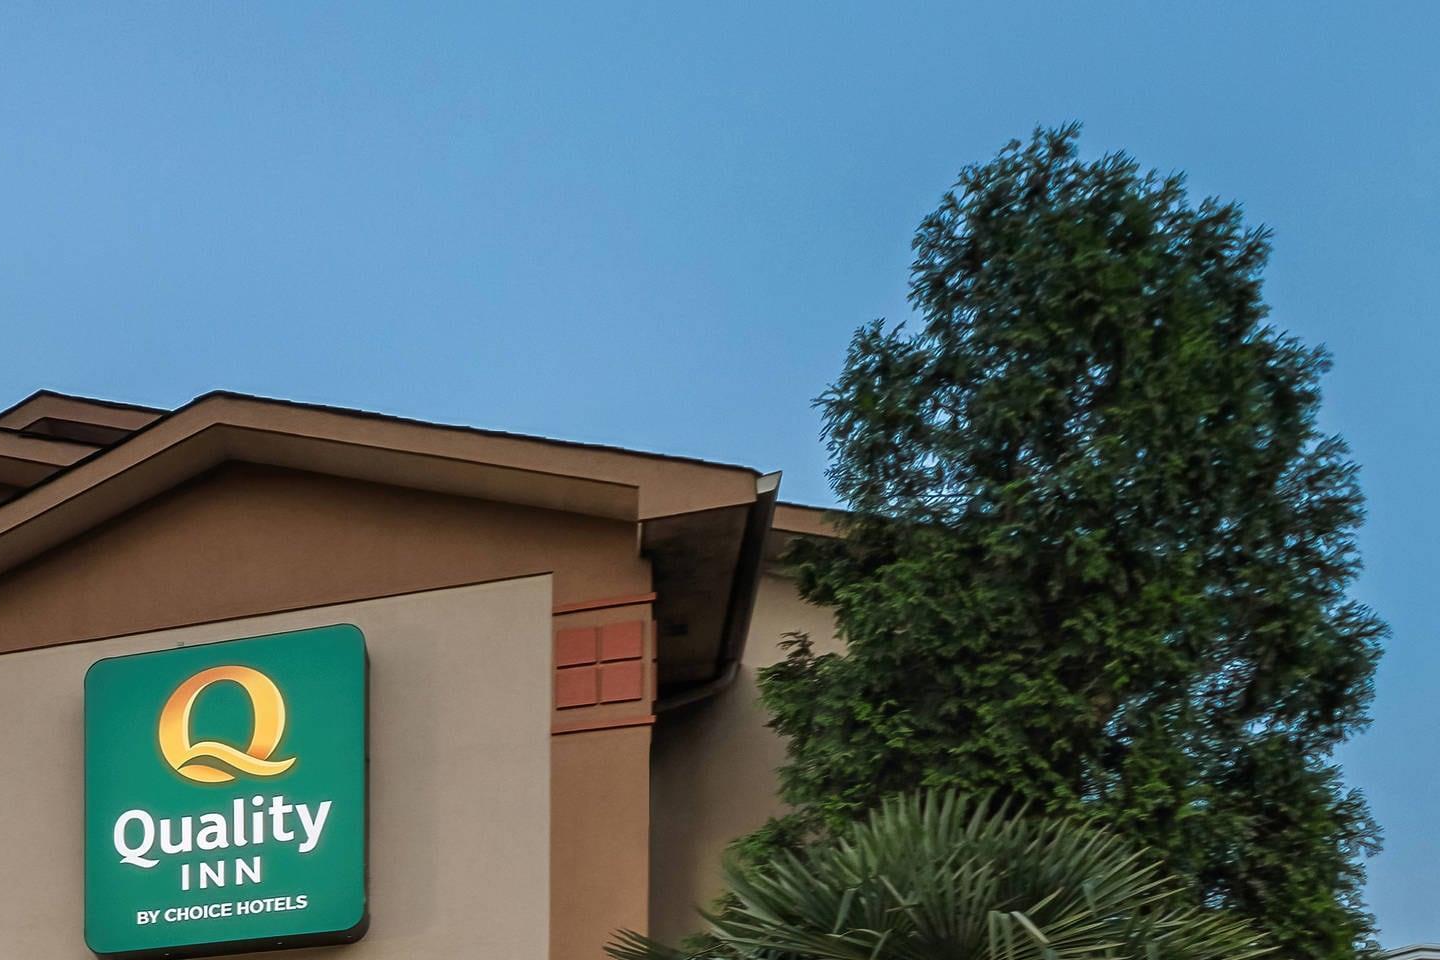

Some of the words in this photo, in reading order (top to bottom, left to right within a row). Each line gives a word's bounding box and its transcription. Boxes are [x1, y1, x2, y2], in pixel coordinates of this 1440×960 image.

[159, 665, 296, 783] Q
[113, 795, 332, 868] Quality
[181, 856, 262, 891] INN
[137, 910, 160, 925] BY
[164, 902, 233, 922] CHOICE
[237, 895, 308, 915] HOTELS
